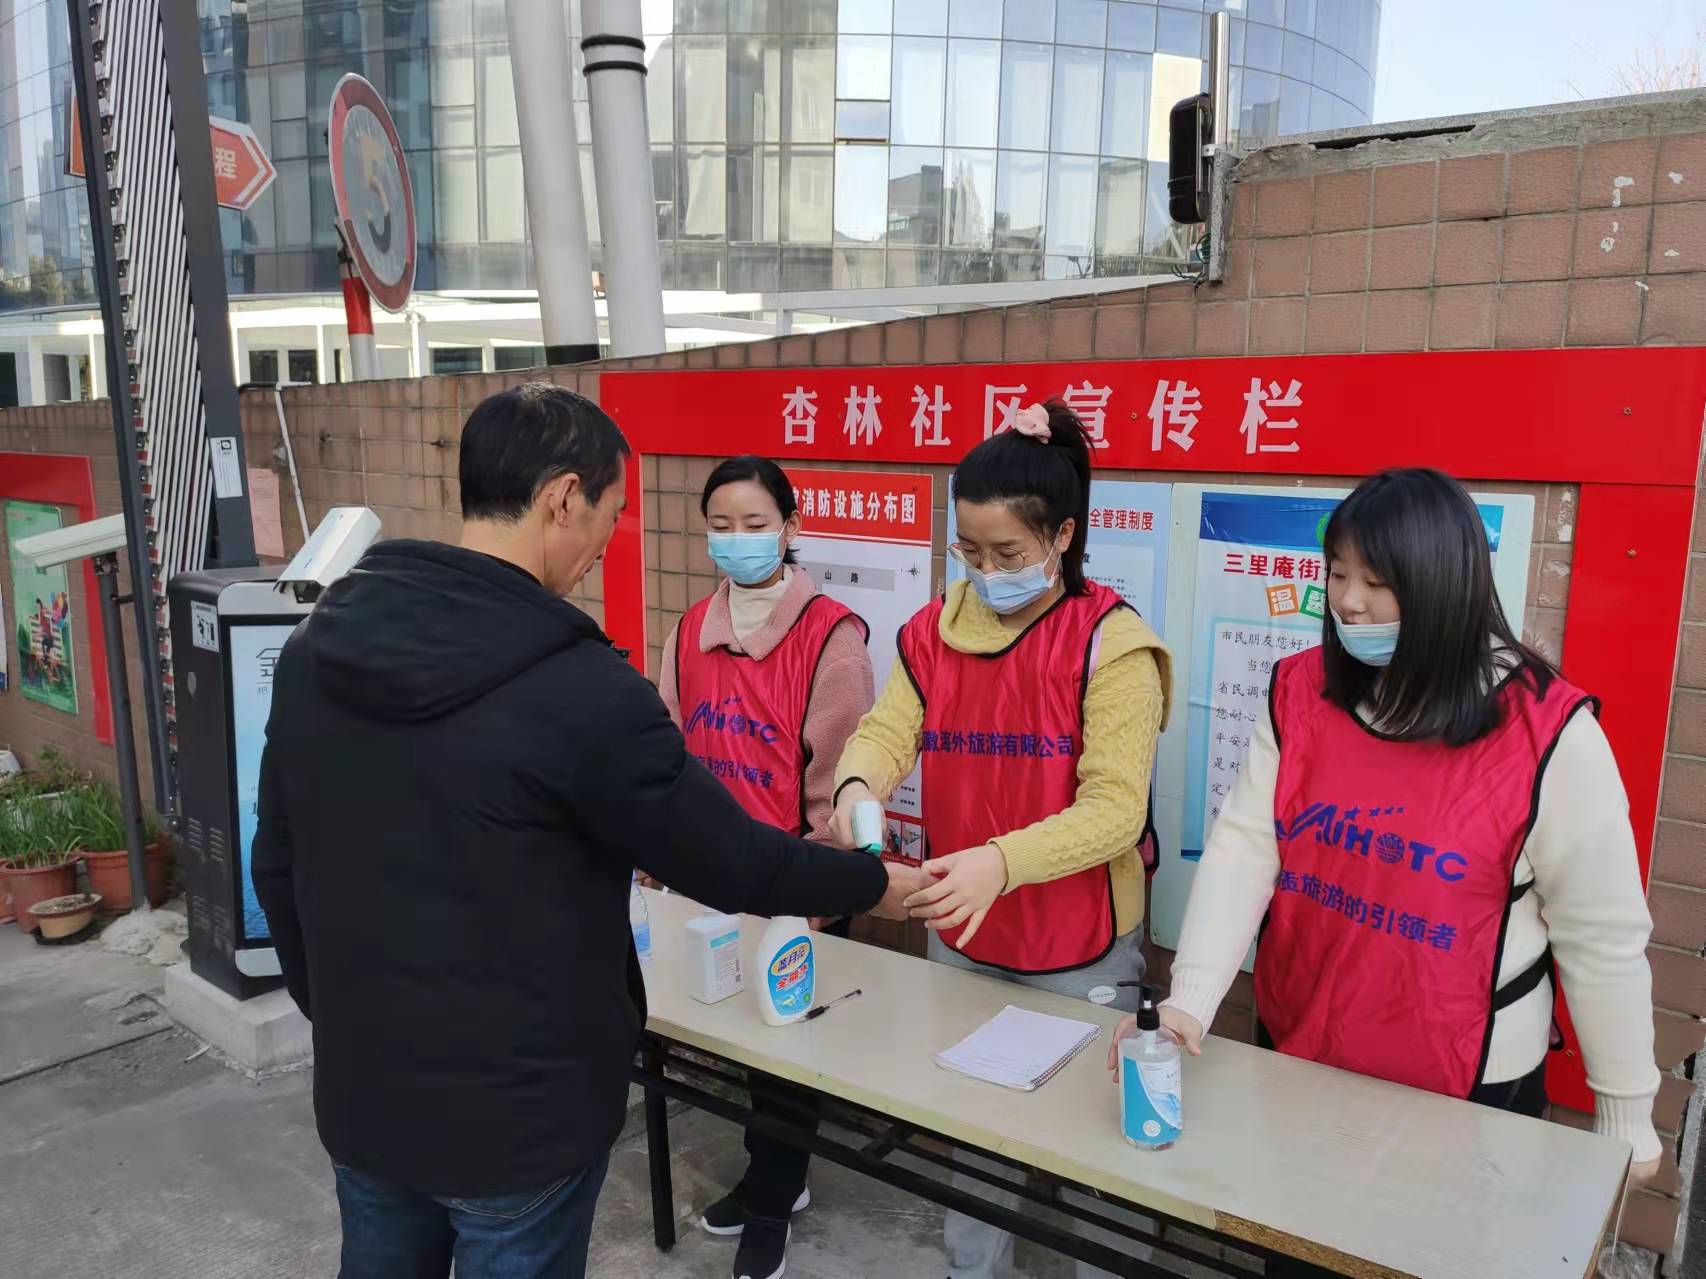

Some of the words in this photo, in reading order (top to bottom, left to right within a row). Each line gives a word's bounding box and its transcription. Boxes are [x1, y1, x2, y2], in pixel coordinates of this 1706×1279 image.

[782, 377, 1303, 455] 杏林社区宣传栏
[1090, 508, 1154, 531] 全管理制度
[1223, 551, 1327, 582] 三里庵街
